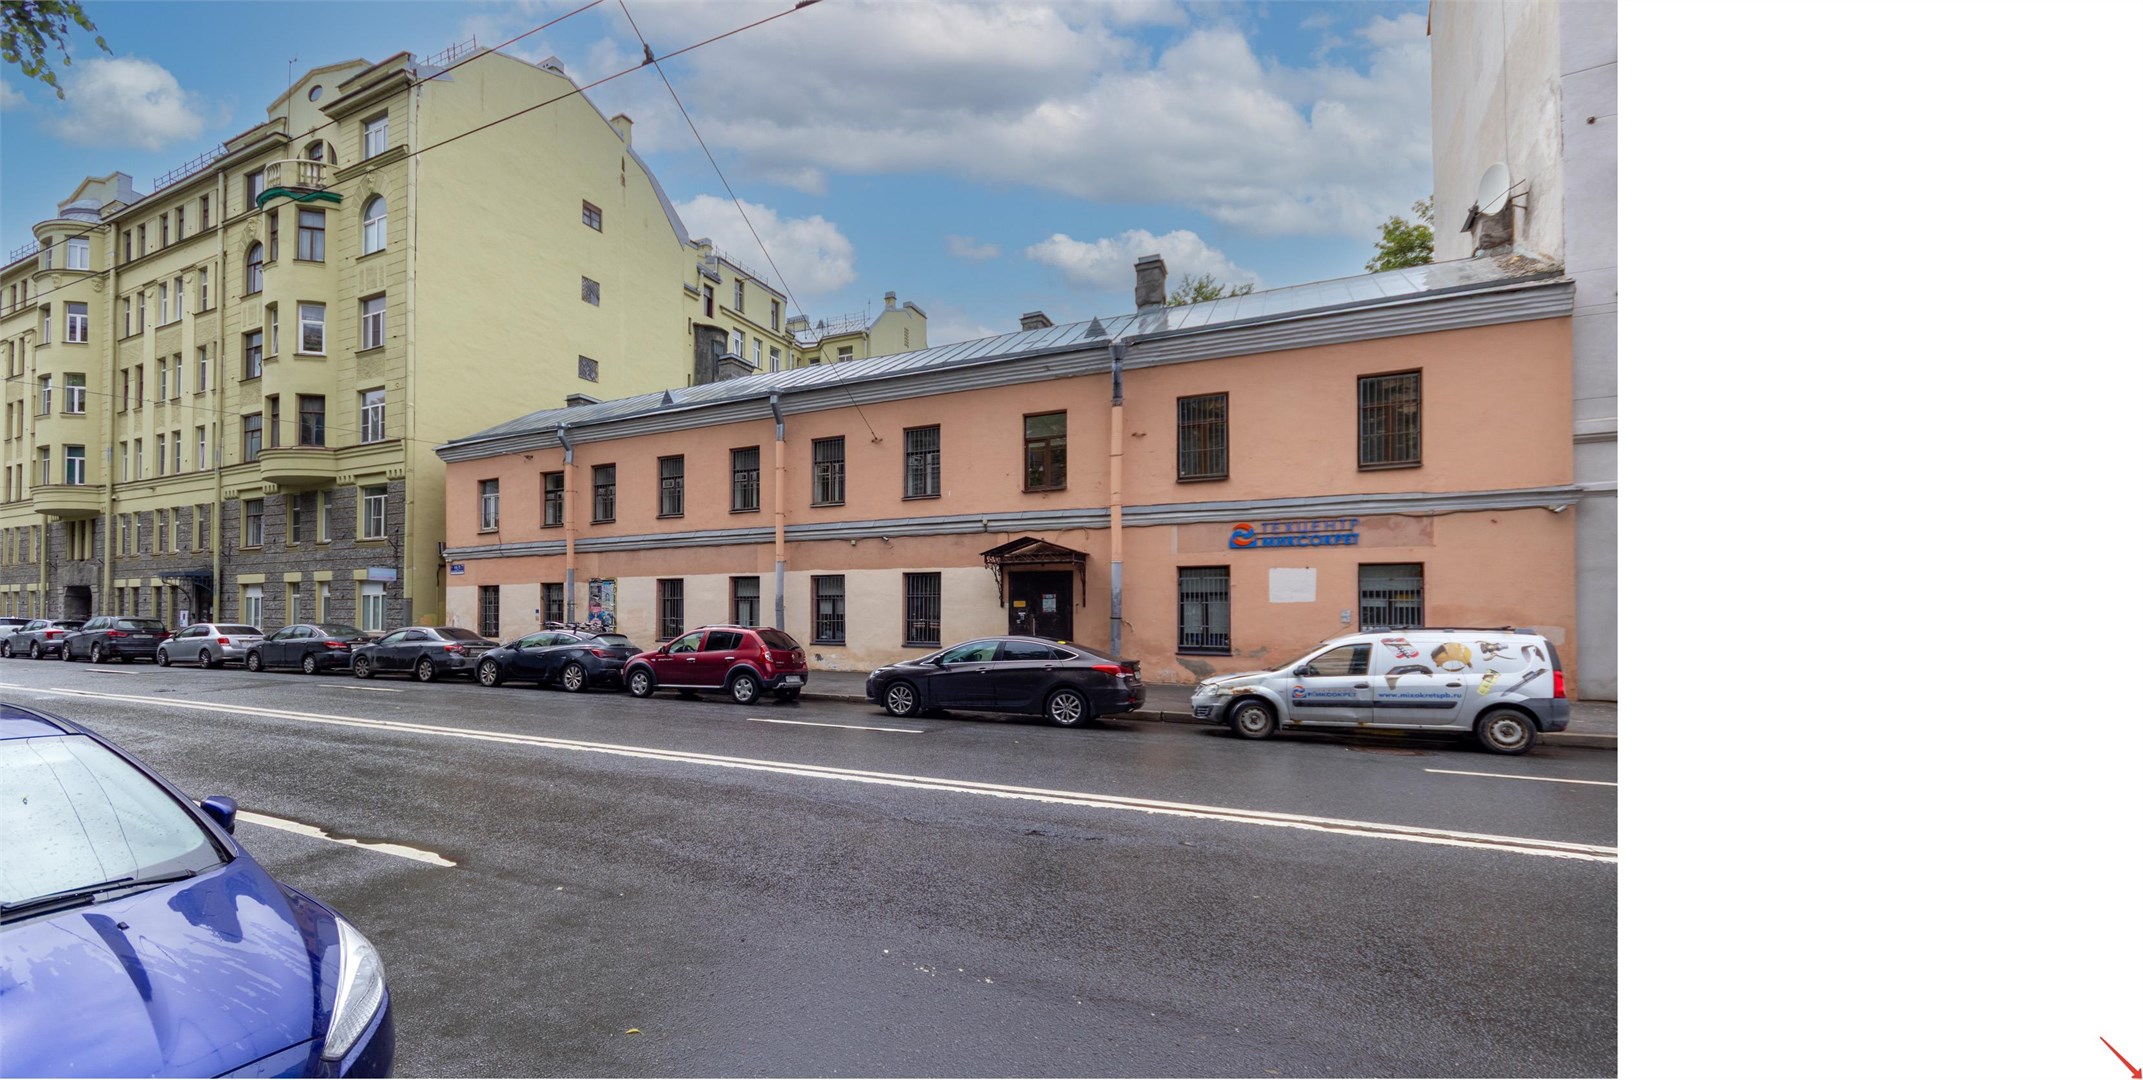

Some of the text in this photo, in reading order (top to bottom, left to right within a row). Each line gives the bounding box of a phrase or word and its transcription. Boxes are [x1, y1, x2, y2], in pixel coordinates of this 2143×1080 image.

[1262, 518, 1360, 534] ТЕХЦЕНТР
[1261, 532, 1360, 547] МИКСОКРЕТ
[1378, 691, 1462, 699] www.mixokretspb.ru
